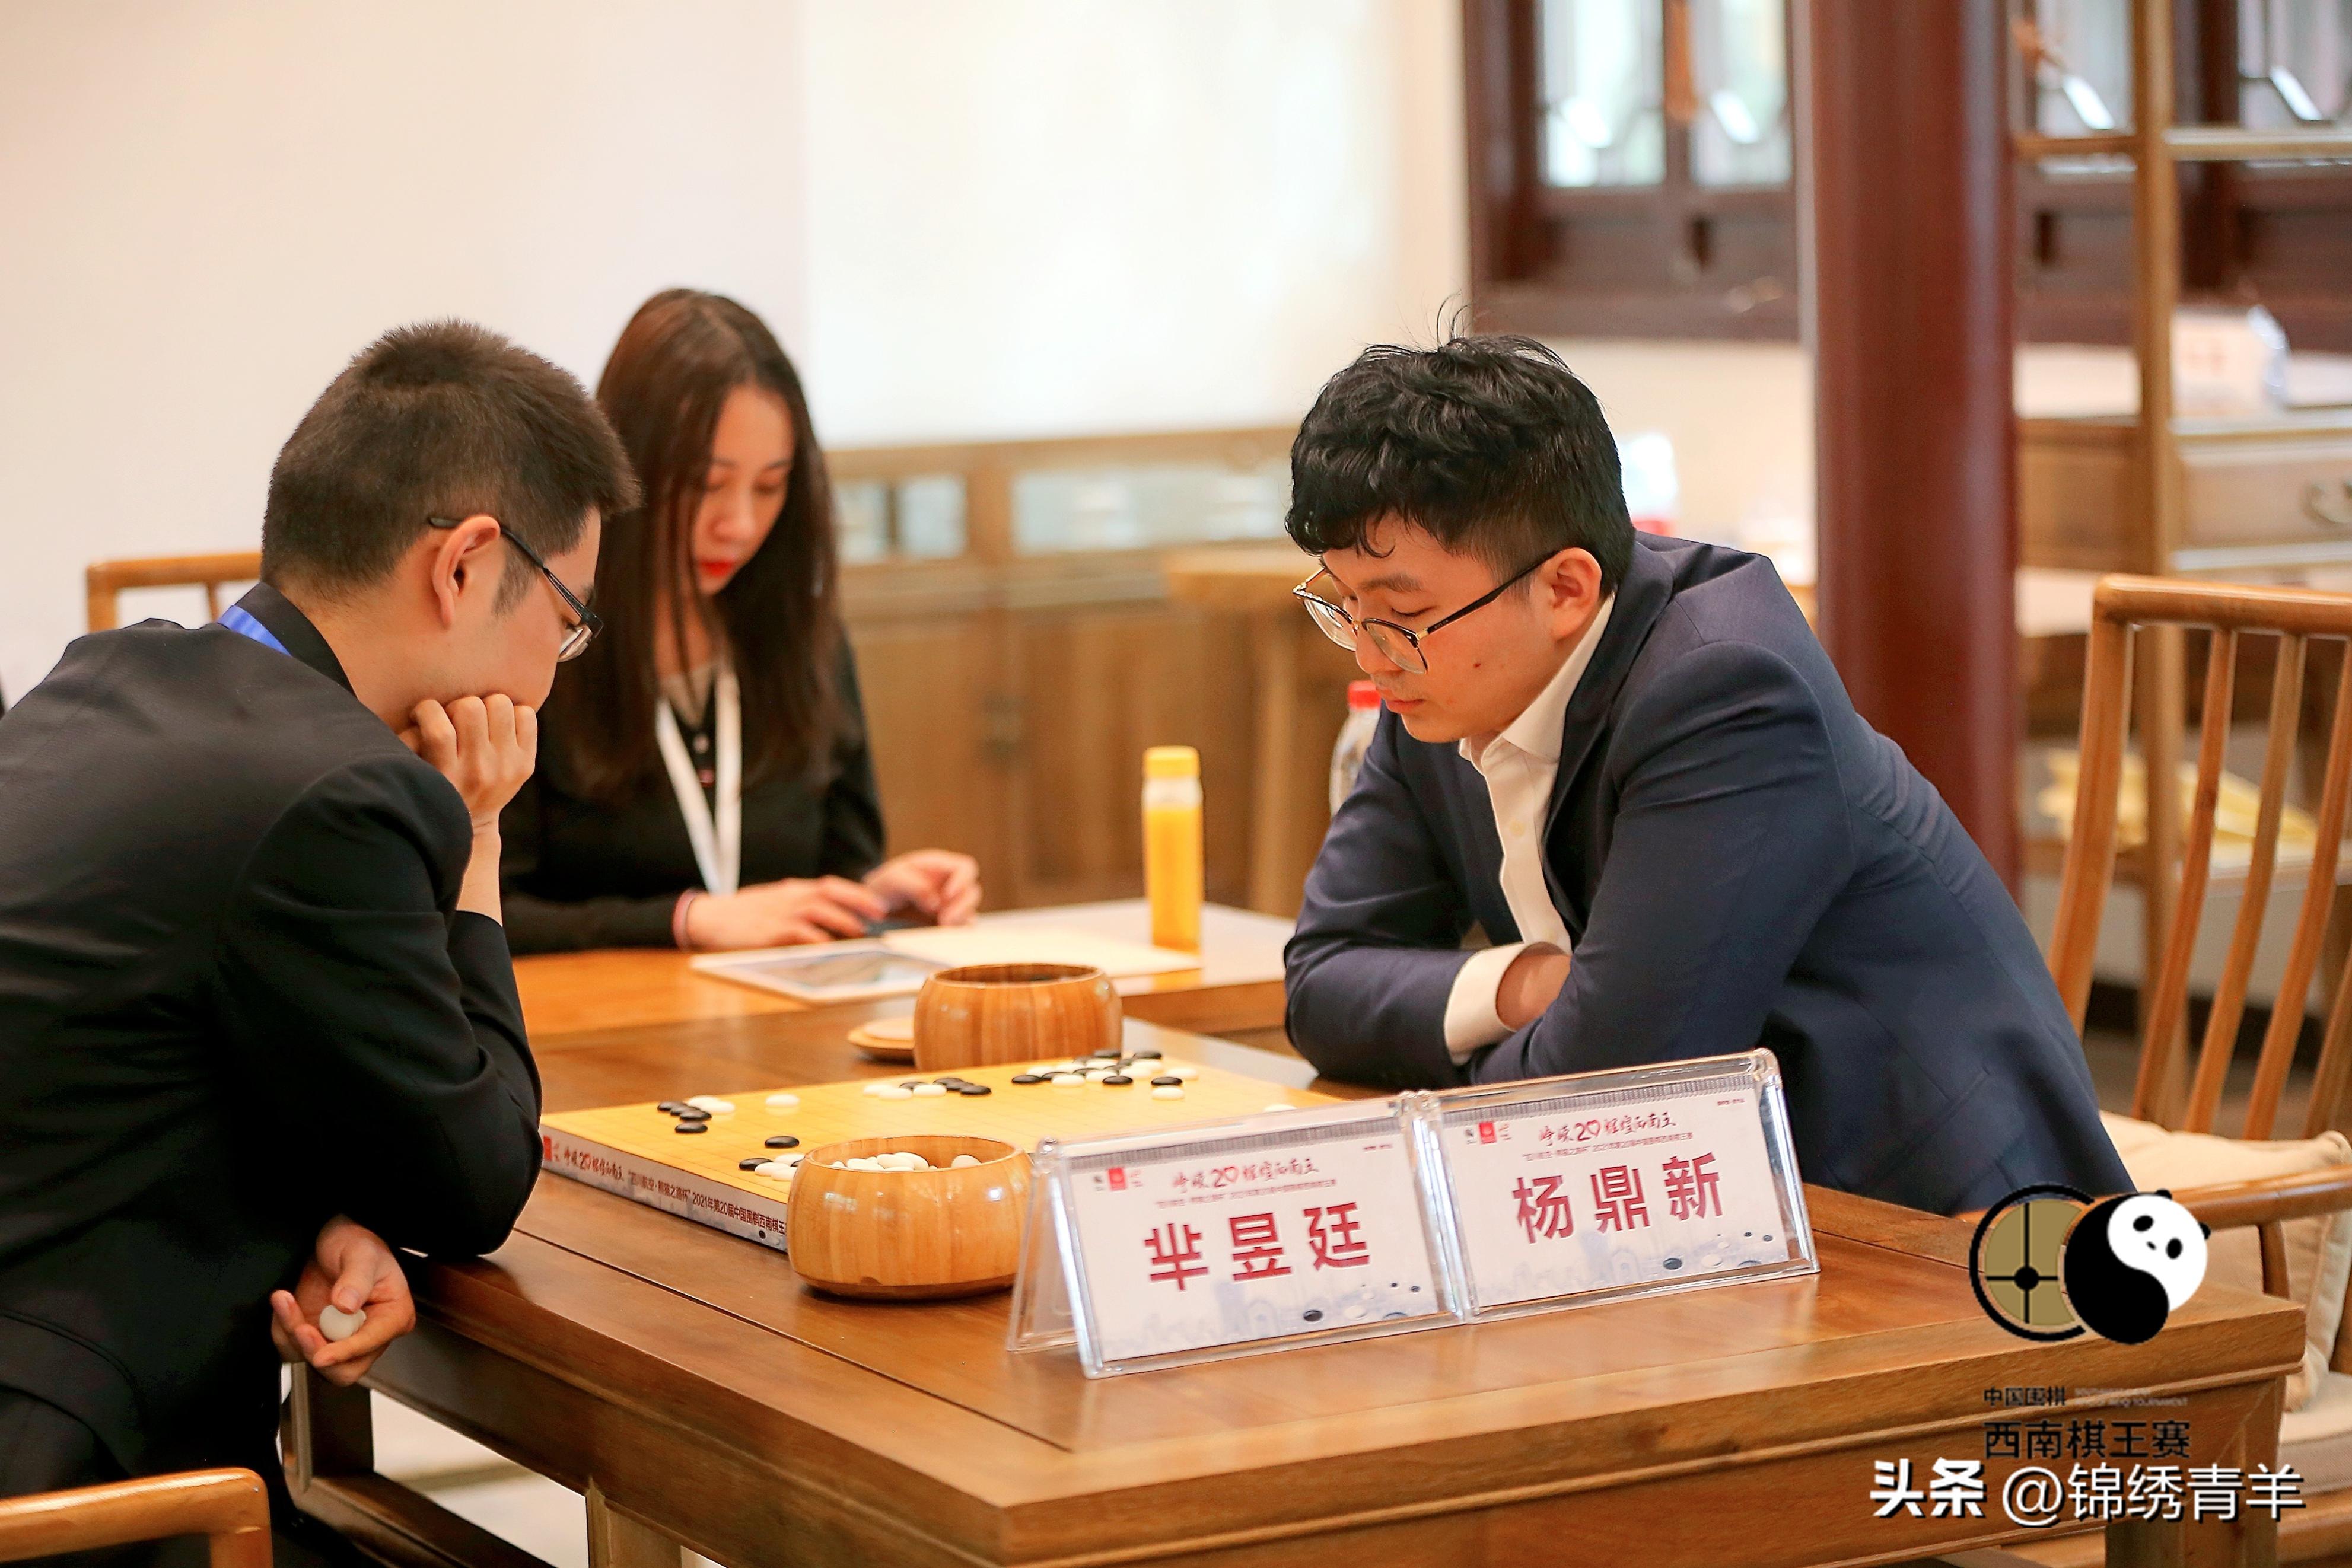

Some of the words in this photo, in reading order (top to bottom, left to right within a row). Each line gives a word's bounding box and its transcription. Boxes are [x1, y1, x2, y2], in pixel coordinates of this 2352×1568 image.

[692, 1192, 787, 1235] 2021年第20届中国围棋西南棋王
[1513, 1152, 1723, 1244] 杨鼎新
[1144, 1202, 1370, 1292] 芈昱廷
